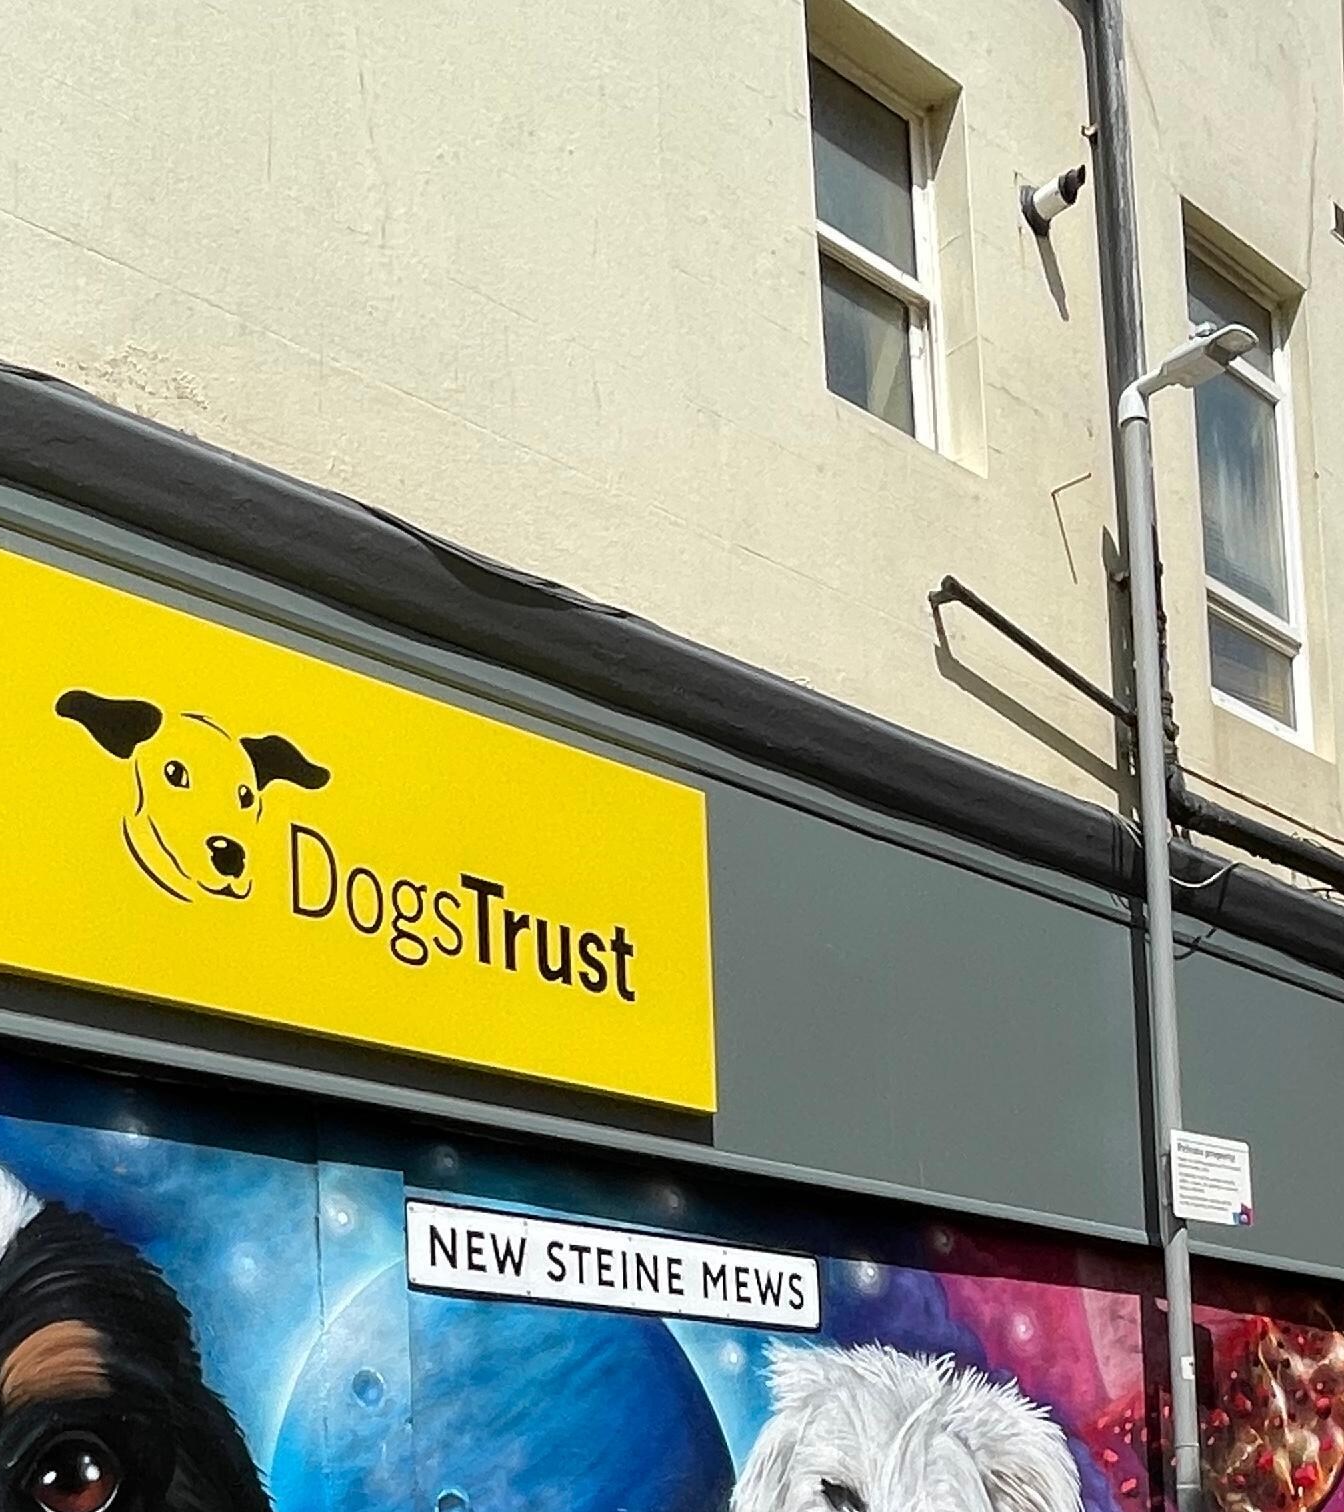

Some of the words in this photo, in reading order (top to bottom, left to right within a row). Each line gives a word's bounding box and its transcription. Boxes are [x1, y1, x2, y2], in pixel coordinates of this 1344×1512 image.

[429, 1225, 527, 1278] NEW
[546, 1240, 685, 1296] STEINE
[702, 1261, 805, 1310] MEWS
